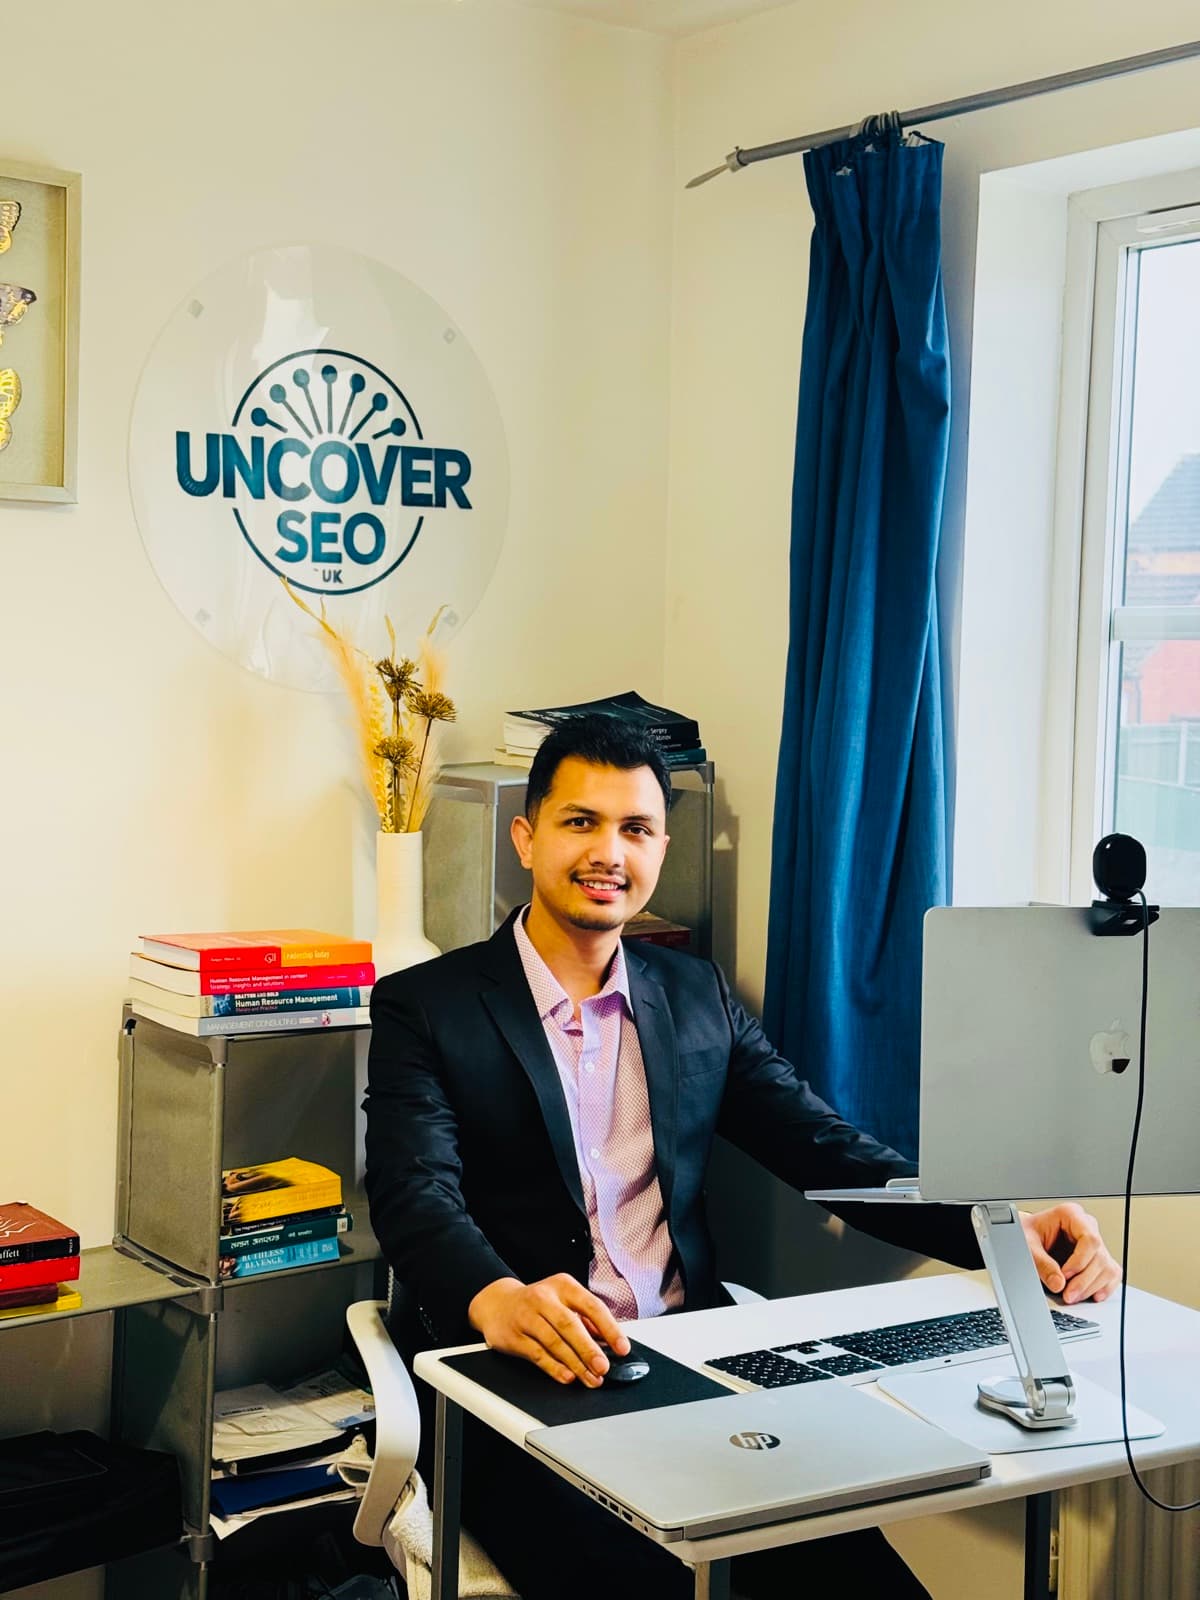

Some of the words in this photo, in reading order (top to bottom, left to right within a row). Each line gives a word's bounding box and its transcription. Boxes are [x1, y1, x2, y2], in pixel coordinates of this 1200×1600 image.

[176, 431, 473, 509] UNCOVER
[275, 510, 386, 565] SEO
[322, 569, 344, 584] UK
[235, 1000, 260, 1008] Human
[261, 998, 293, 1006] Resource
[294, 994, 338, 1004] Management
[242, 1248, 285, 1262] RUTHLESS
[245, 1257, 283, 1269] REVENGE
[735, 1432, 775, 1450] hp
